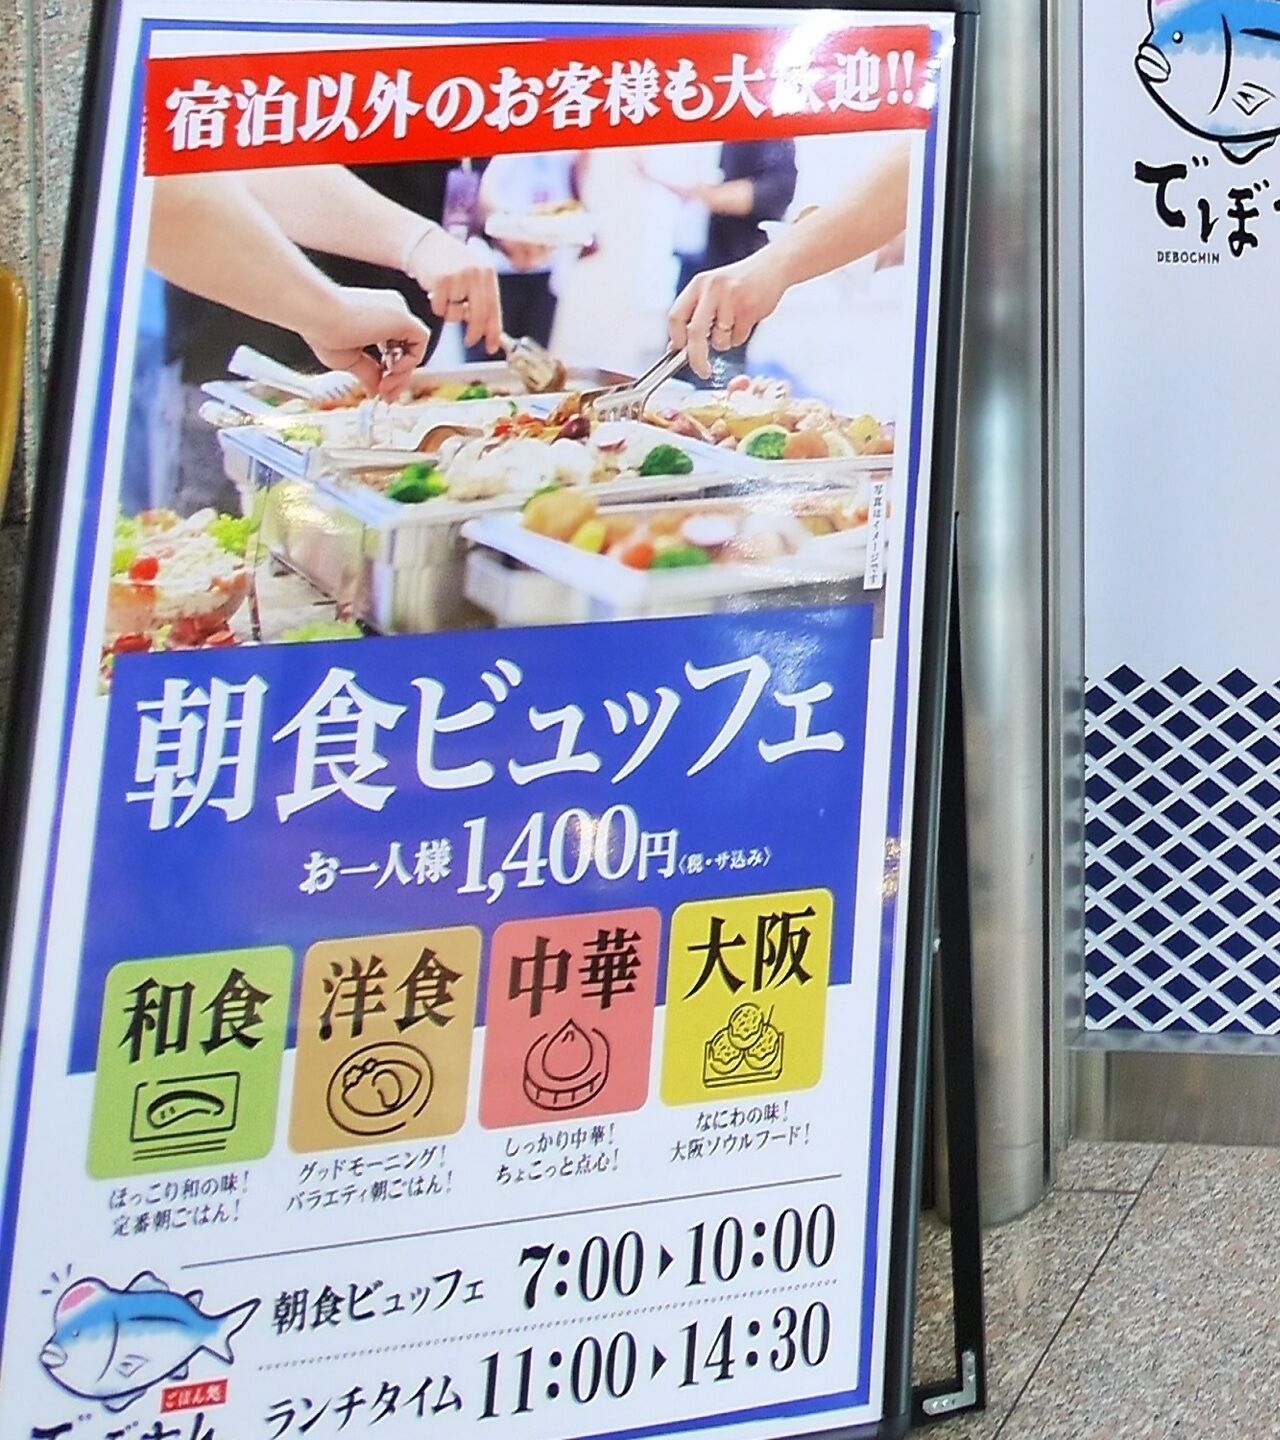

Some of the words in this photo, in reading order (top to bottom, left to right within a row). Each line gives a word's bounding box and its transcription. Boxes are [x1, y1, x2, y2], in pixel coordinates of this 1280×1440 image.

[1156, 250, 1221, 265] DEBOCHIN
[125, 656, 846, 831] 朝食ビュッフェ
[299, 838, 453, 895] お一人様
[318, 945, 465, 1039] 洋食
[506, 924, 645, 1019] 中華
[681, 904, 819, 1000] 大阪
[117, 966, 274, 1065] 和食
[270, 1266, 487, 1336] 朝食ビュッフェ
[517, 1227, 646, 1314] 7:00
[686, 1202, 837, 1286] 10:00
[165, 1383, 224, 1408] ごはん処
[264, 1372, 466, 1434] ランチタイム
[478, 1330, 638, 1422] 11:00
[678, 1300, 831, 1388] 14:30
